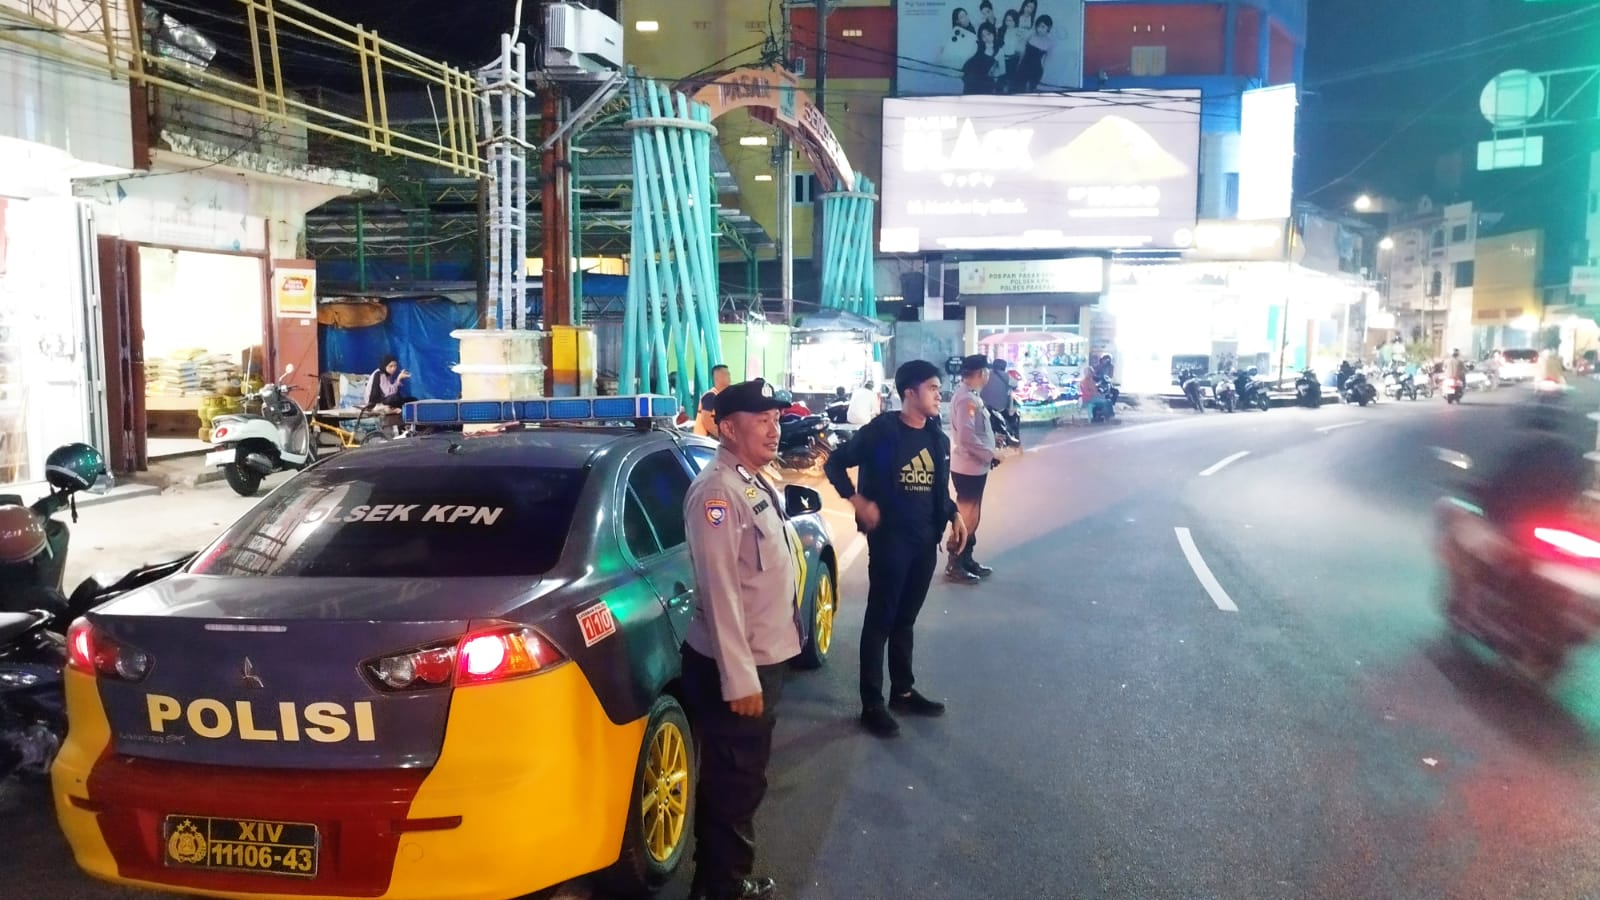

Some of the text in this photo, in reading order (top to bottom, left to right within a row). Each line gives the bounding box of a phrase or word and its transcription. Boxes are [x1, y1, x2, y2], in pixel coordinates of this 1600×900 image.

[899, 470, 934, 485] adida
[300, 504, 504, 526] OLSEK KPN
[585, 610, 612, 638] 110
[146, 693, 376, 743] POLISI
[238, 821, 284, 843] XIV
[211, 843, 313, 871] 11106-43
